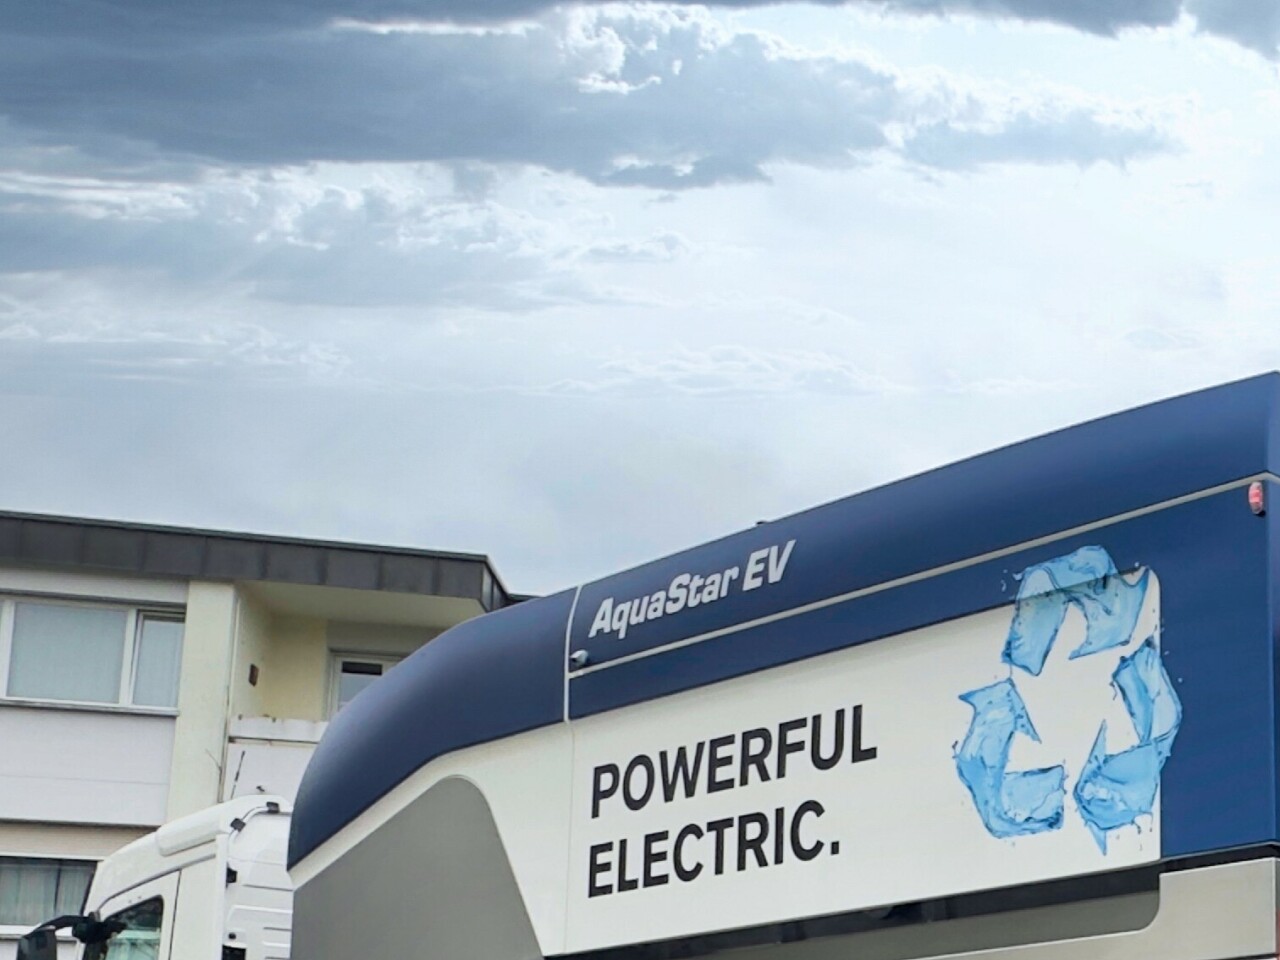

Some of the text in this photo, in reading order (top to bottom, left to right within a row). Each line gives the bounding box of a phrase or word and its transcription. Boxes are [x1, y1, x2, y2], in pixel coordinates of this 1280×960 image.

[588, 540, 796, 638] AquaStar EV
[591, 704, 878, 819] POWERFUL
[588, 800, 840, 899] ELECTRIC.
